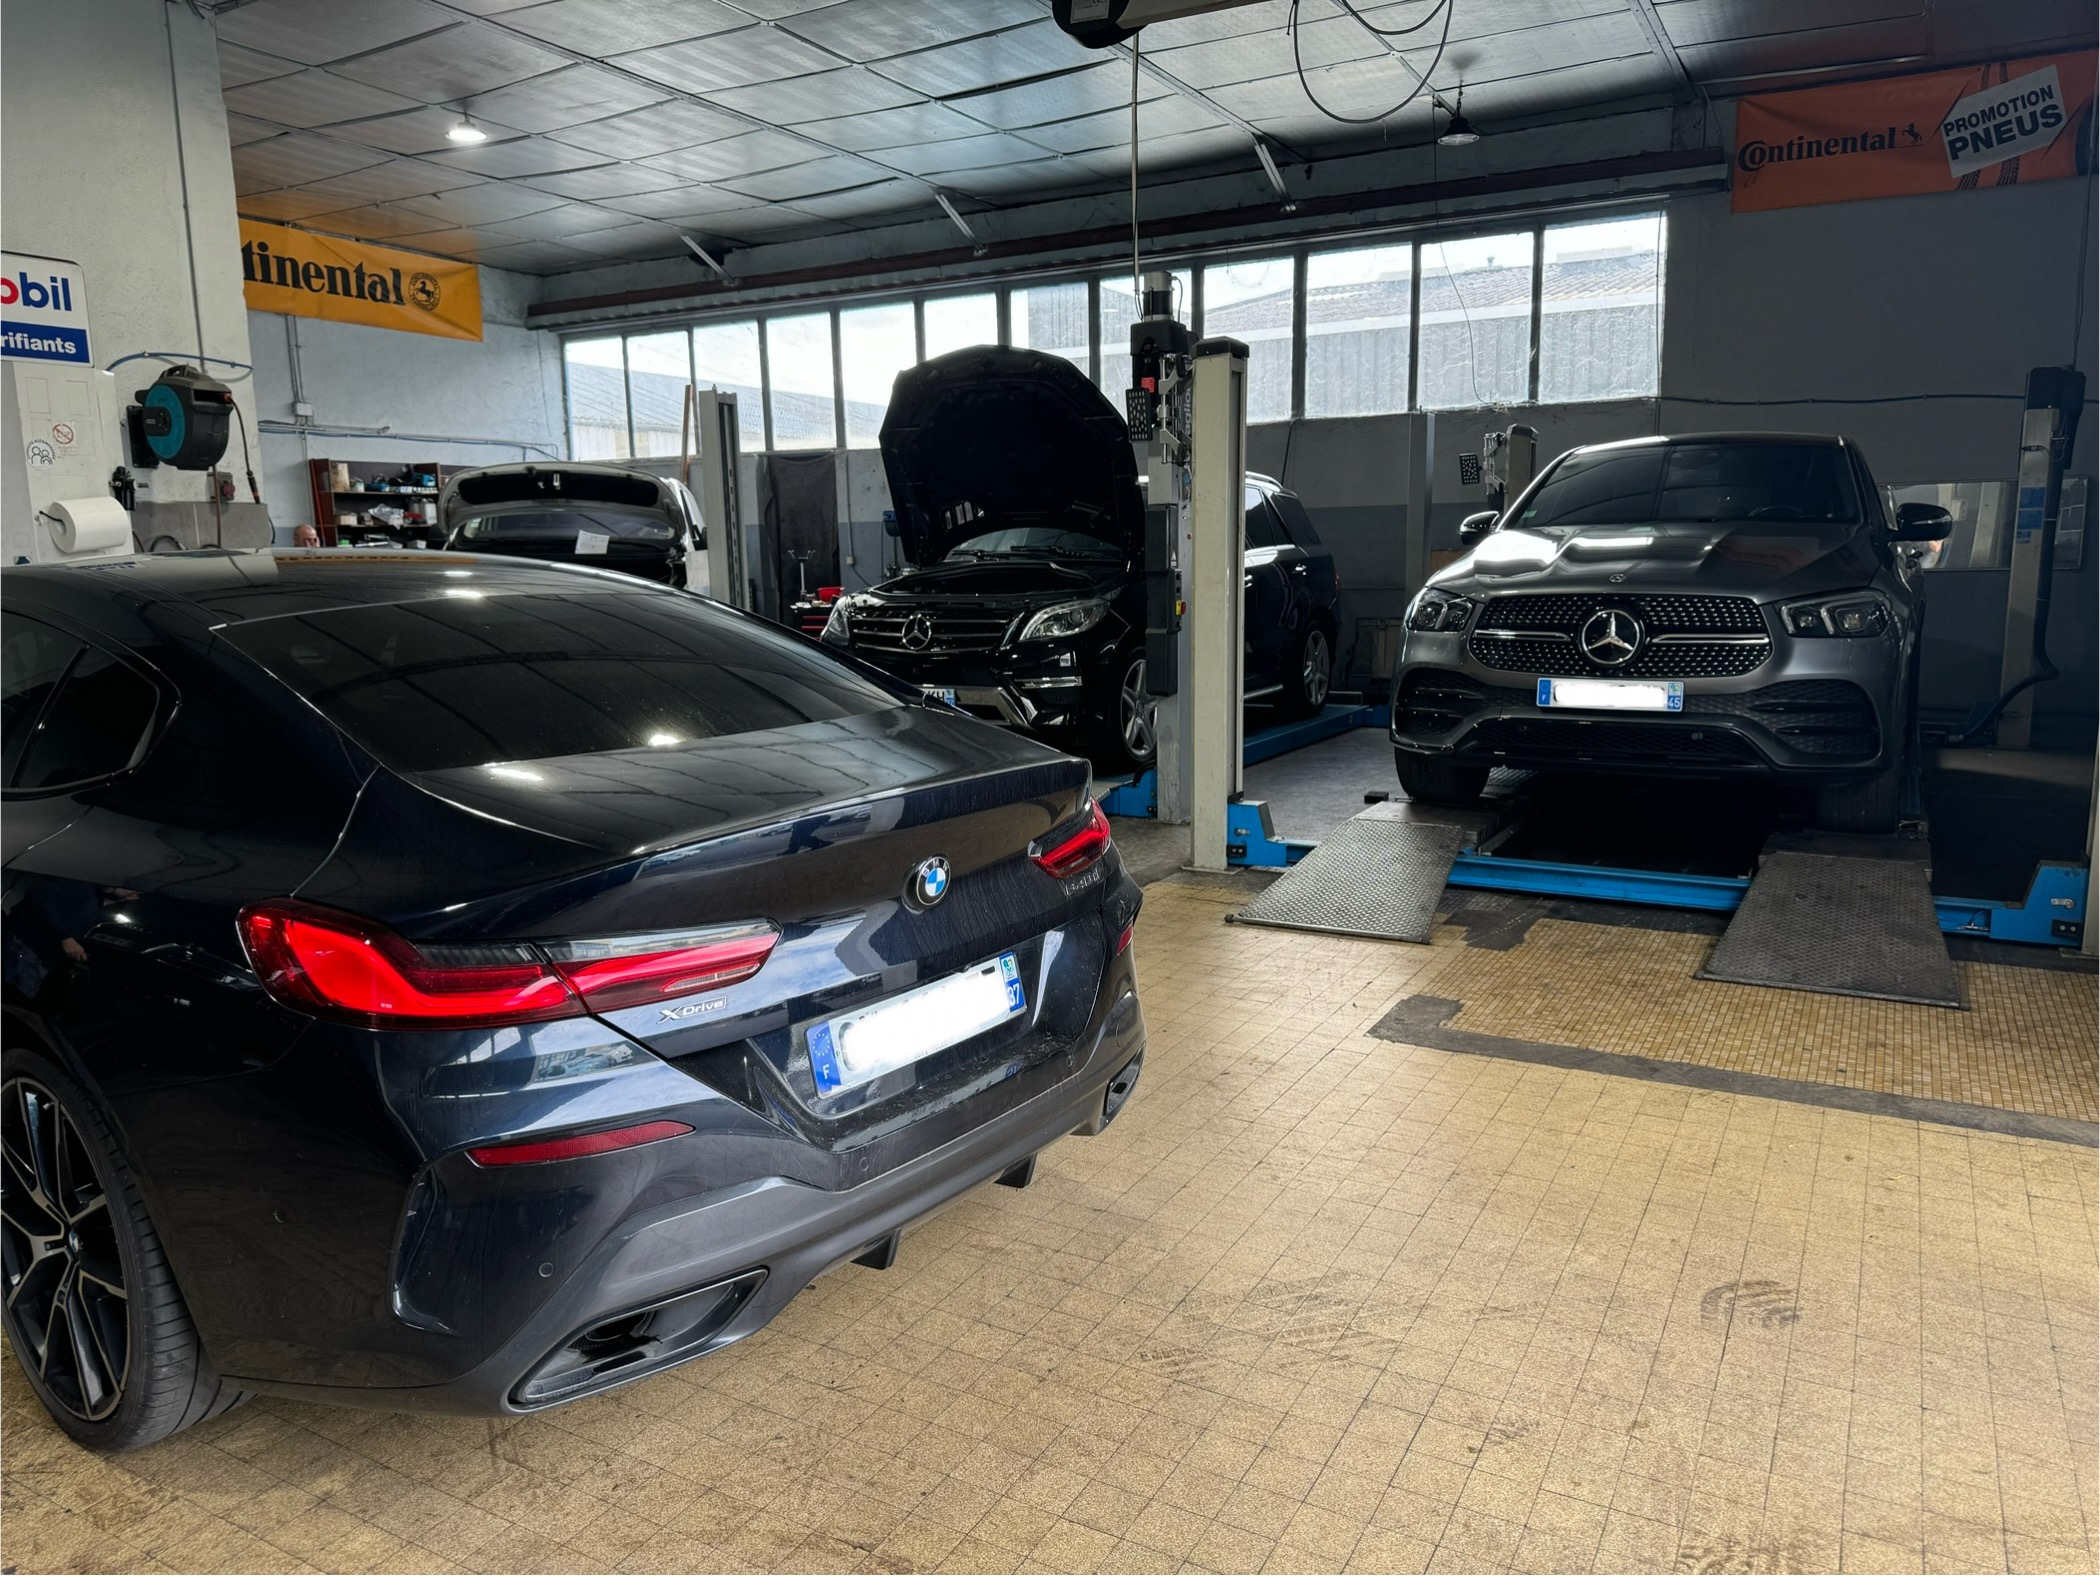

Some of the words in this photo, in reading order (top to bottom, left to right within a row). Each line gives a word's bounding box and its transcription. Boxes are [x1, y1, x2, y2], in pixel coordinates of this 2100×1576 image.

[1943, 84, 2054, 137] PROMOTION
[1738, 127, 1897, 172] Continental
[1947, 104, 2063, 161] PNEUS
[241, 240, 406, 306] tinental
[1668, 697, 1681, 708] 45
[921, 858, 949, 878] BMW
[1006, 983, 1020, 1008] 37
[822, 1063, 830, 1079] F
